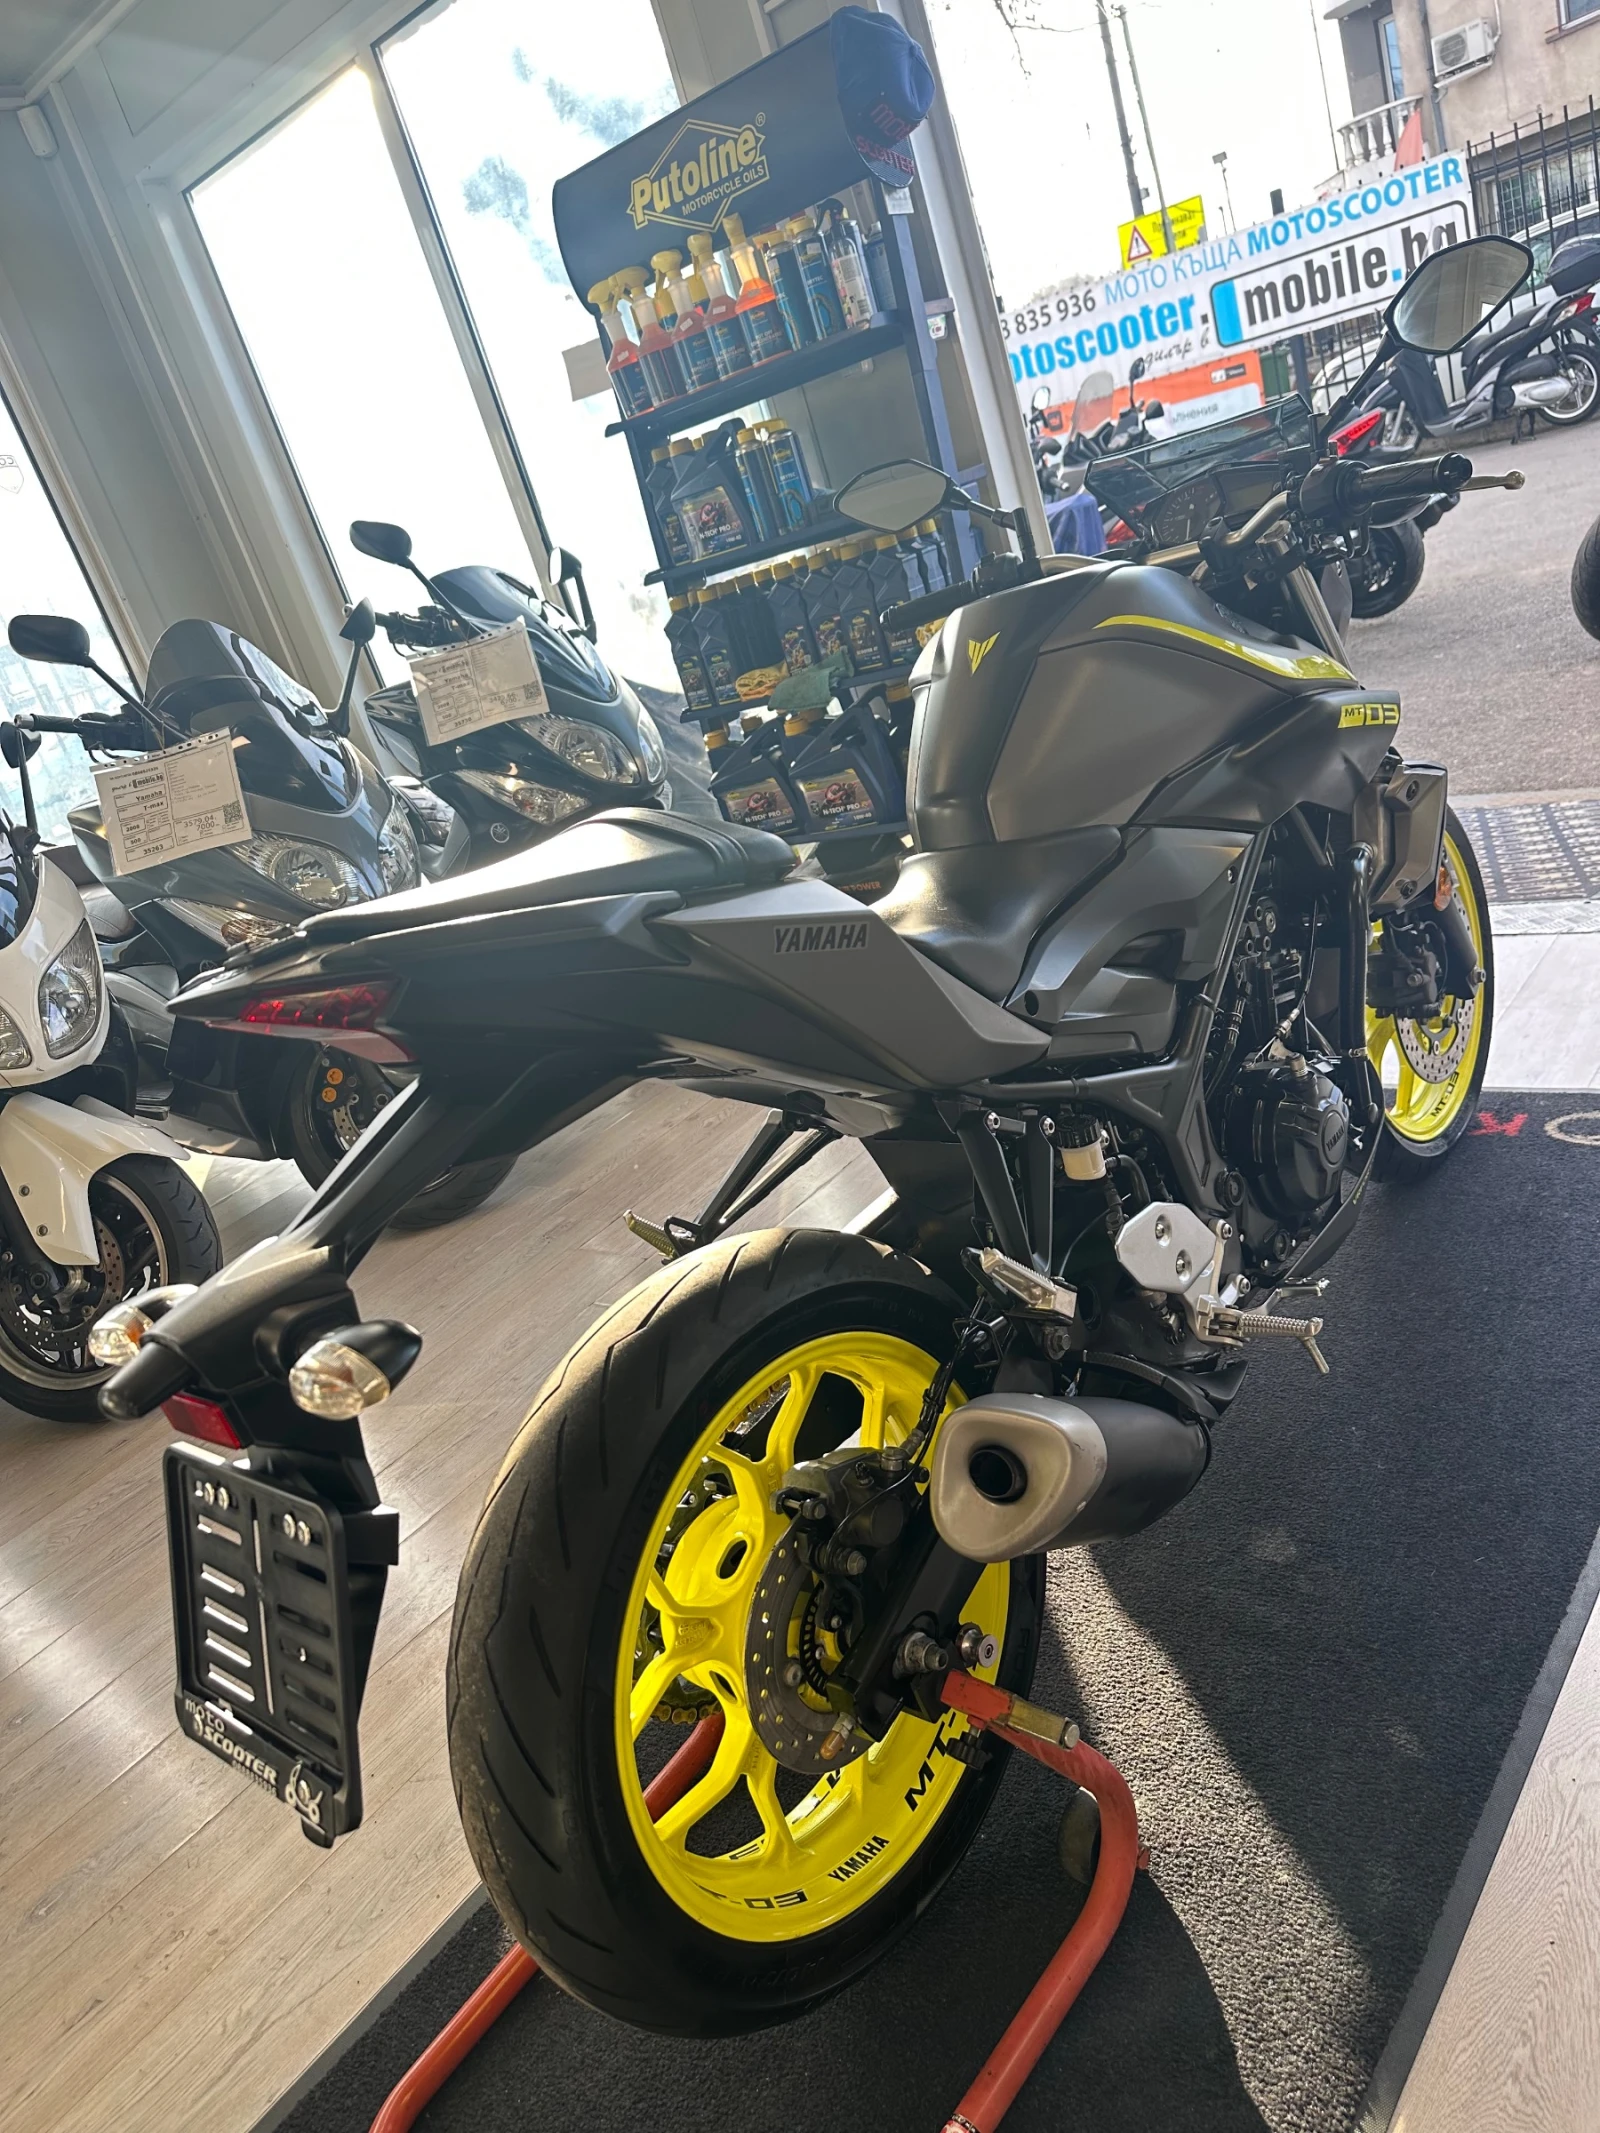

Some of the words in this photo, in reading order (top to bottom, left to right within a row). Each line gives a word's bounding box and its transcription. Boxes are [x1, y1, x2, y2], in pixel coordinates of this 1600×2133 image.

[633, 130, 757, 223] Putoline
[682, 177, 742, 216] MOTORCYCLE
[743, 165, 764, 184] OILS
[1015, 305, 1051, 334] 835
[1056, 289, 1096, 321] 936
[1104, 264, 1167, 306] МОТО
[1172, 238, 1242, 283] КЪЩА
[1247, 157, 1463, 257] MOTOSCOOTER
[1008, 293, 1209, 385] otoscooter.
[719, 524, 731, 533] PRO
[1344, 707, 1364, 718] MT
[1364, 703, 1400, 726] 03
[136, 789, 163, 801] Yamaha
[143, 801, 164, 811] T-max
[846, 803, 861, 811] PRO
[184, 814, 215, 828] 3579.04
[196, 821, 215, 831] 7000
[768, 811, 781, 819] PRO
[143, 844, 164, 855] 35263
[775, 923, 868, 953] YAMAHA
[1431, 1071, 1460, 1117] MT-03
[1326, 1126, 1345, 1151] YAMAHA
[185, 1698, 225, 1732] moto
[204, 1725, 278, 1785] SCOOTER
[904, 1712, 957, 1812] MT-
[828, 1835, 890, 1883] YAMAHA
